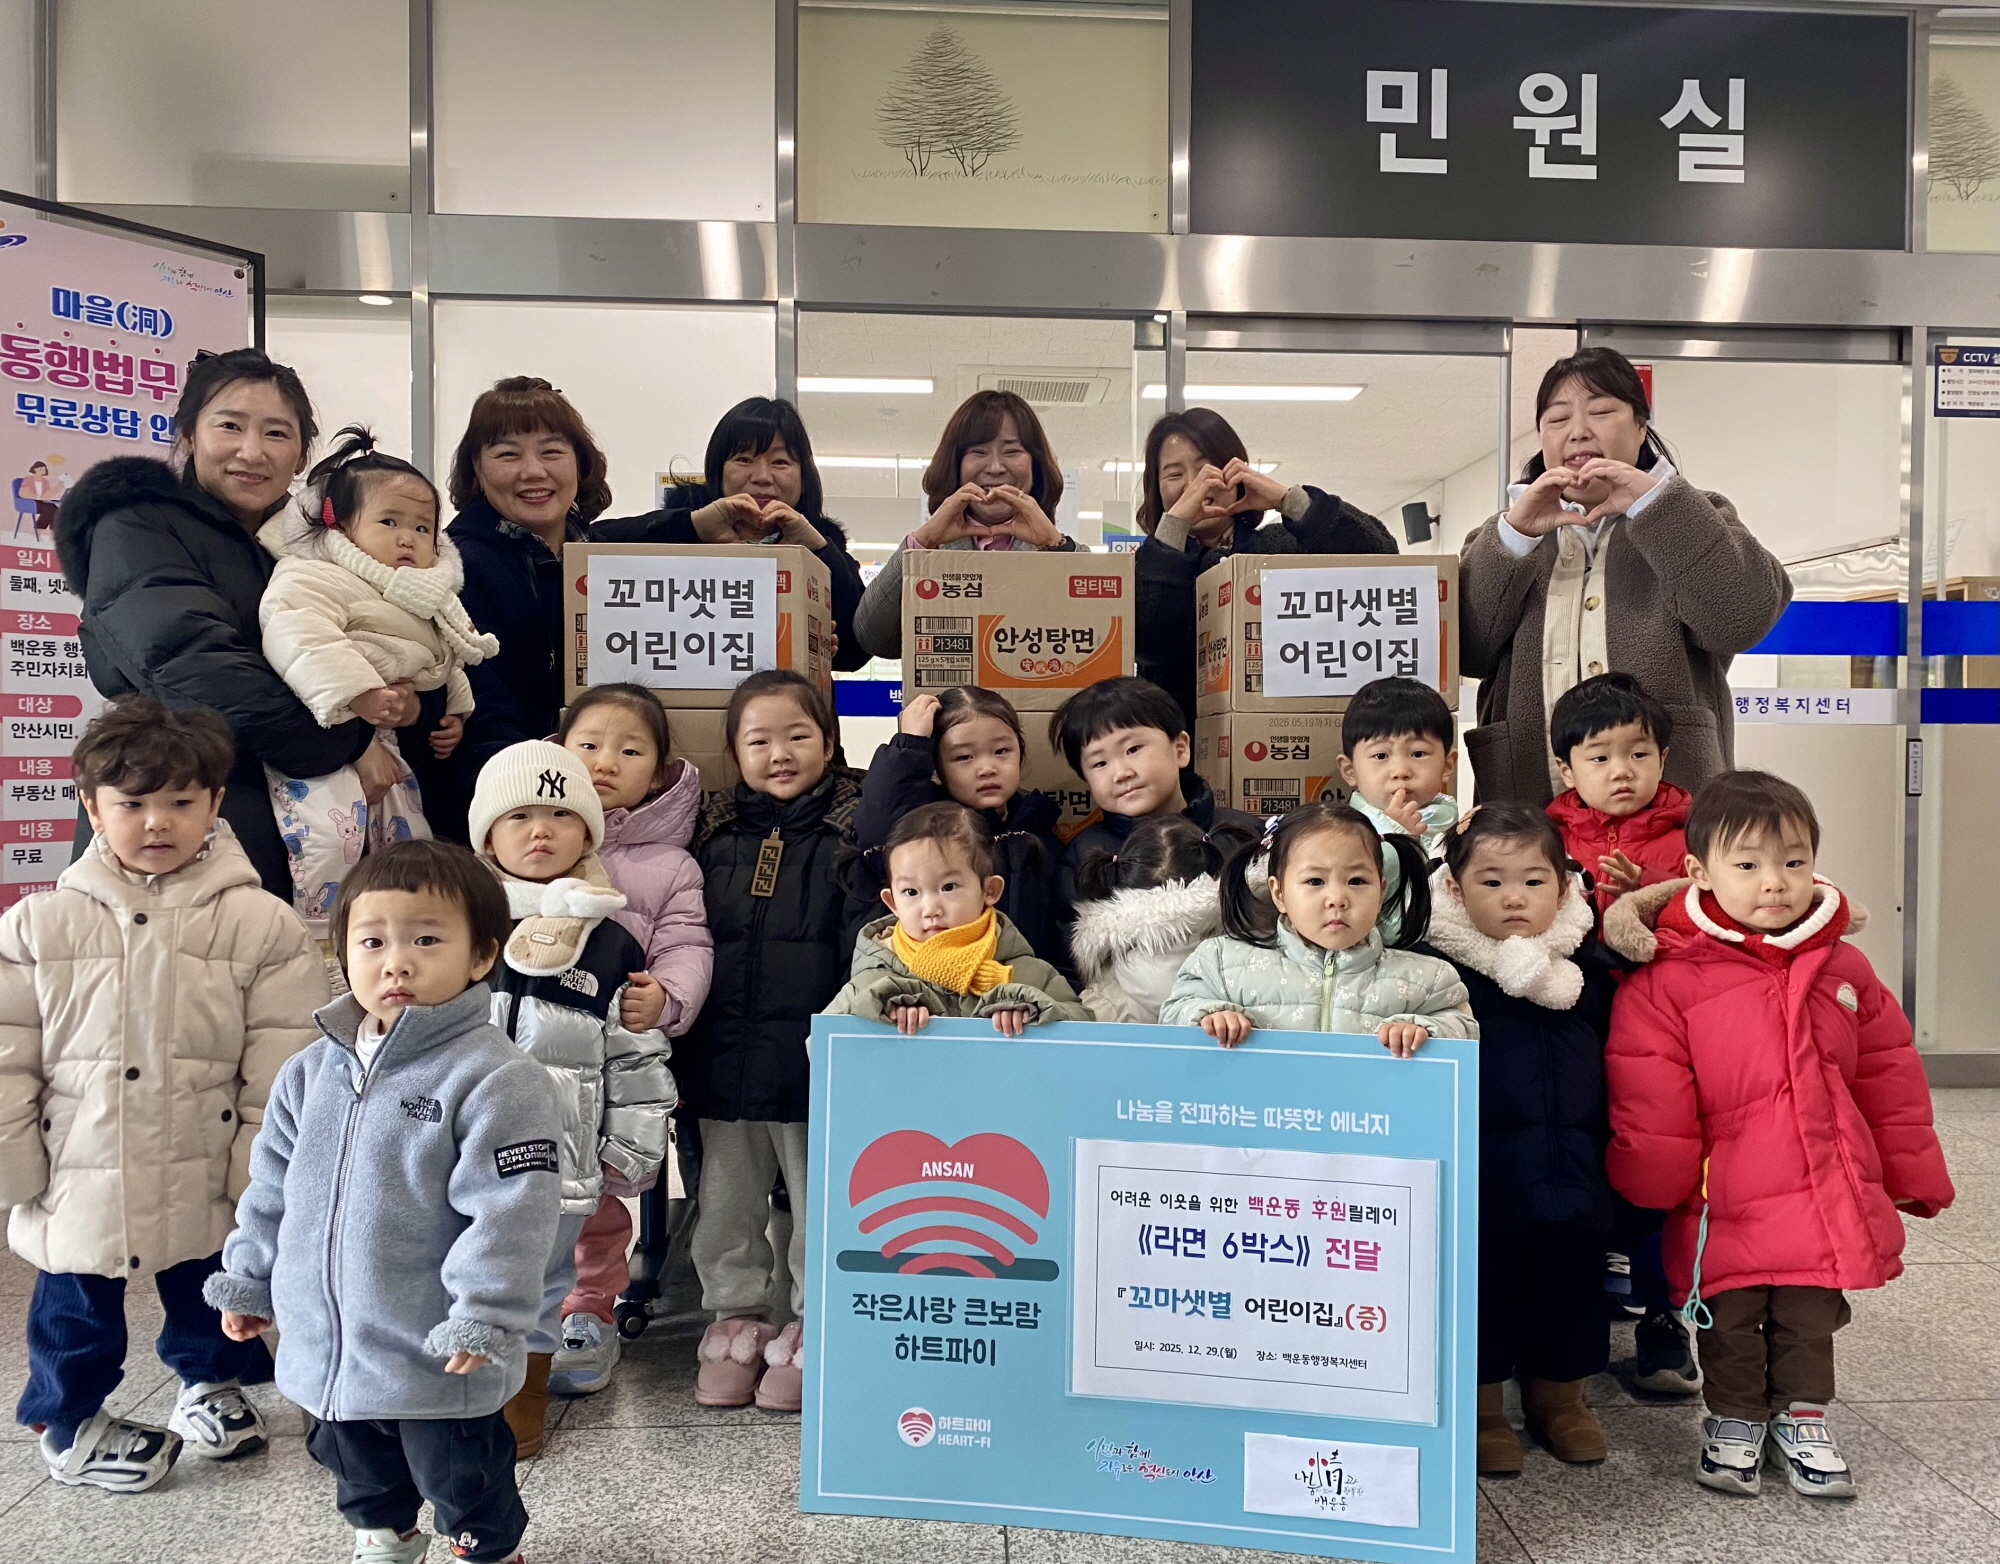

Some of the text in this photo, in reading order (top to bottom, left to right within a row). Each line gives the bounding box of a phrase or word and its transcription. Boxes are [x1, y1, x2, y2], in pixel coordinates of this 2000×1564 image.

[52, 287, 172, 337] 마을(洞)
[1963, 353, 1990, 362] CCTV
[0, 333, 190, 401] 동행법무
[15, 393, 141, 438] 무료상담
[17, 550, 51, 568] 일시
[9, 575, 42, 594] 둘째,
[942, 582, 982, 599] 농심
[1073, 578, 1118, 595] 멀티팩
[604, 578, 755, 619] 꼬마샛별
[1277, 587, 1419, 627] 꼬마샛별
[17, 613, 52, 630] 장소
[11, 639, 84, 658] 백운동 행
[935, 638, 971, 650] 가3481
[994, 627, 1095, 654] 안성탕면
[605, 630, 755, 672] 어린이집
[1279, 638, 1419, 679] 어린이집
[10, 661, 88, 679] 주민자치회
[18, 697, 53, 714] 대상
[1735, 696, 1851, 714] 행정복지센터
[11, 723, 79, 740] 안산시민,
[1270, 744, 1310, 760] 농심
[19, 759, 53, 776] 내용
[537, 769, 567, 799] NY
[11, 785, 56, 802] 부동산
[1263, 800, 1296, 812] 가3481
[19, 822, 54, 839] 비용
[12, 849, 43, 865] 무료
[570, 968, 588, 978] THE
[560, 980, 584, 992] FACE
[400, 1100, 433, 1113] NORTH
[418, 1096, 435, 1106] THE
[407, 1110, 432, 1122] FACE
[1117, 1100, 1390, 1136] 나눔을 전파하는 따뜻한 에너지
[498, 1146, 527, 1159] NEVER
[921, 1161, 975, 1179] ANSAN
[1110, 1190, 1397, 1226] 어려운 이웃을 위한 백운동 후원릴레이
[1325, 1237, 1381, 1272] 전달
[852, 1293, 1042, 1329] 작은사랑 큰보람
[895, 1334, 996, 1366] 하트파이
[1134, 1340, 1367, 1370] 일시: 2025. 12. 29.(월) 장소: 백운동행정복지센터
[938, 1416, 991, 1433] 하트파이
[938, 1434, 990, 1448] HEART-FI
[1086, 1437, 1123, 1460] 시민과
[1098, 1460, 1217, 1483] 자유로운 혁신도시 안산
[1315, 1496, 1348, 1511] 백운동
